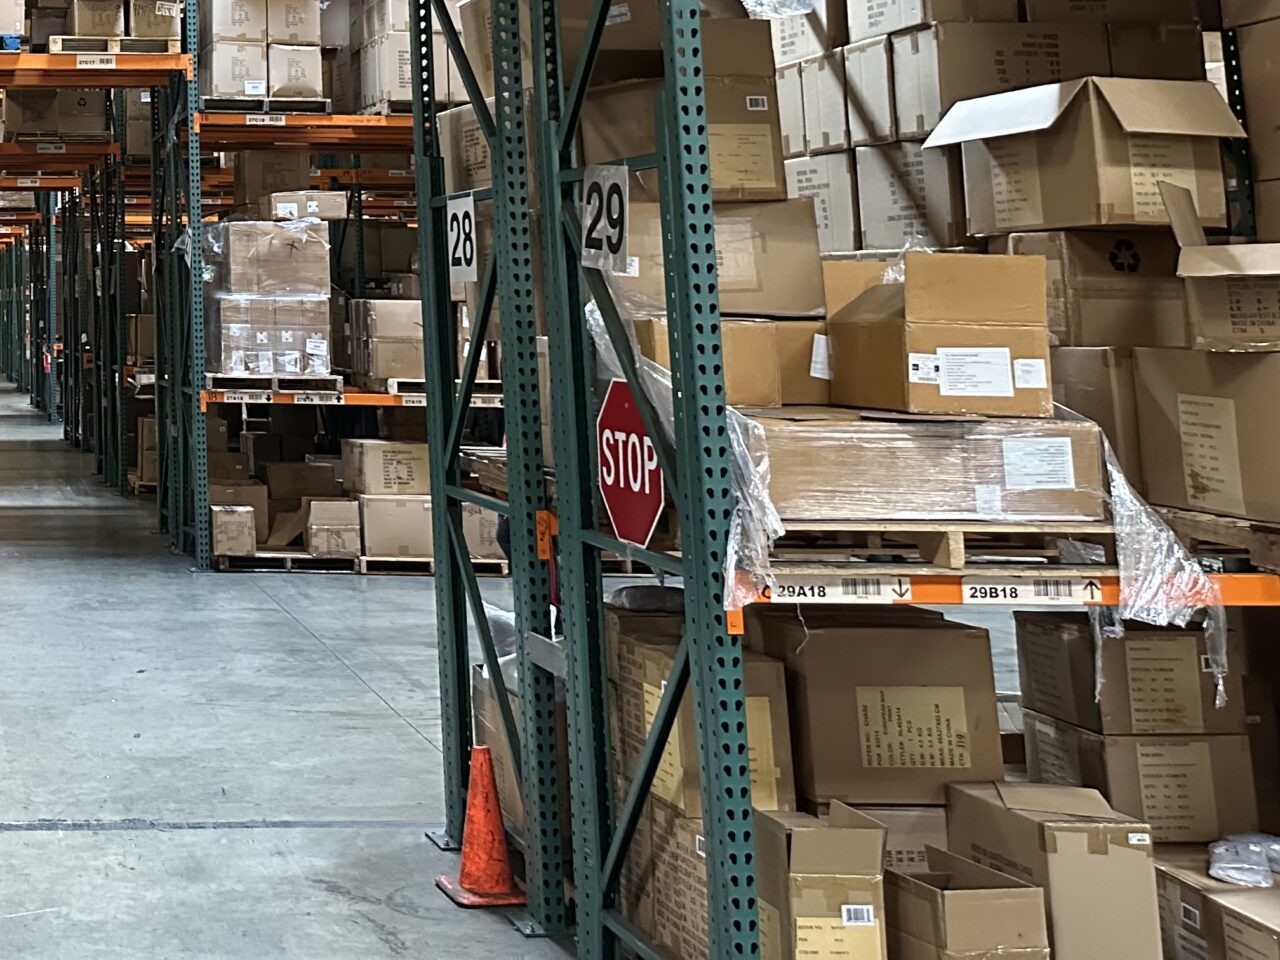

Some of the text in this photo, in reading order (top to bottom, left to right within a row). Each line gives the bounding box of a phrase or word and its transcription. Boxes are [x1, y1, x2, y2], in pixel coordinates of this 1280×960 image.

[450, 211, 474, 267] 28
[585, 181, 624, 255] 29
[602, 428, 658, 494] STOP
[777, 585, 826, 597] 29A18
[970, 586, 1018, 599] 29B18
